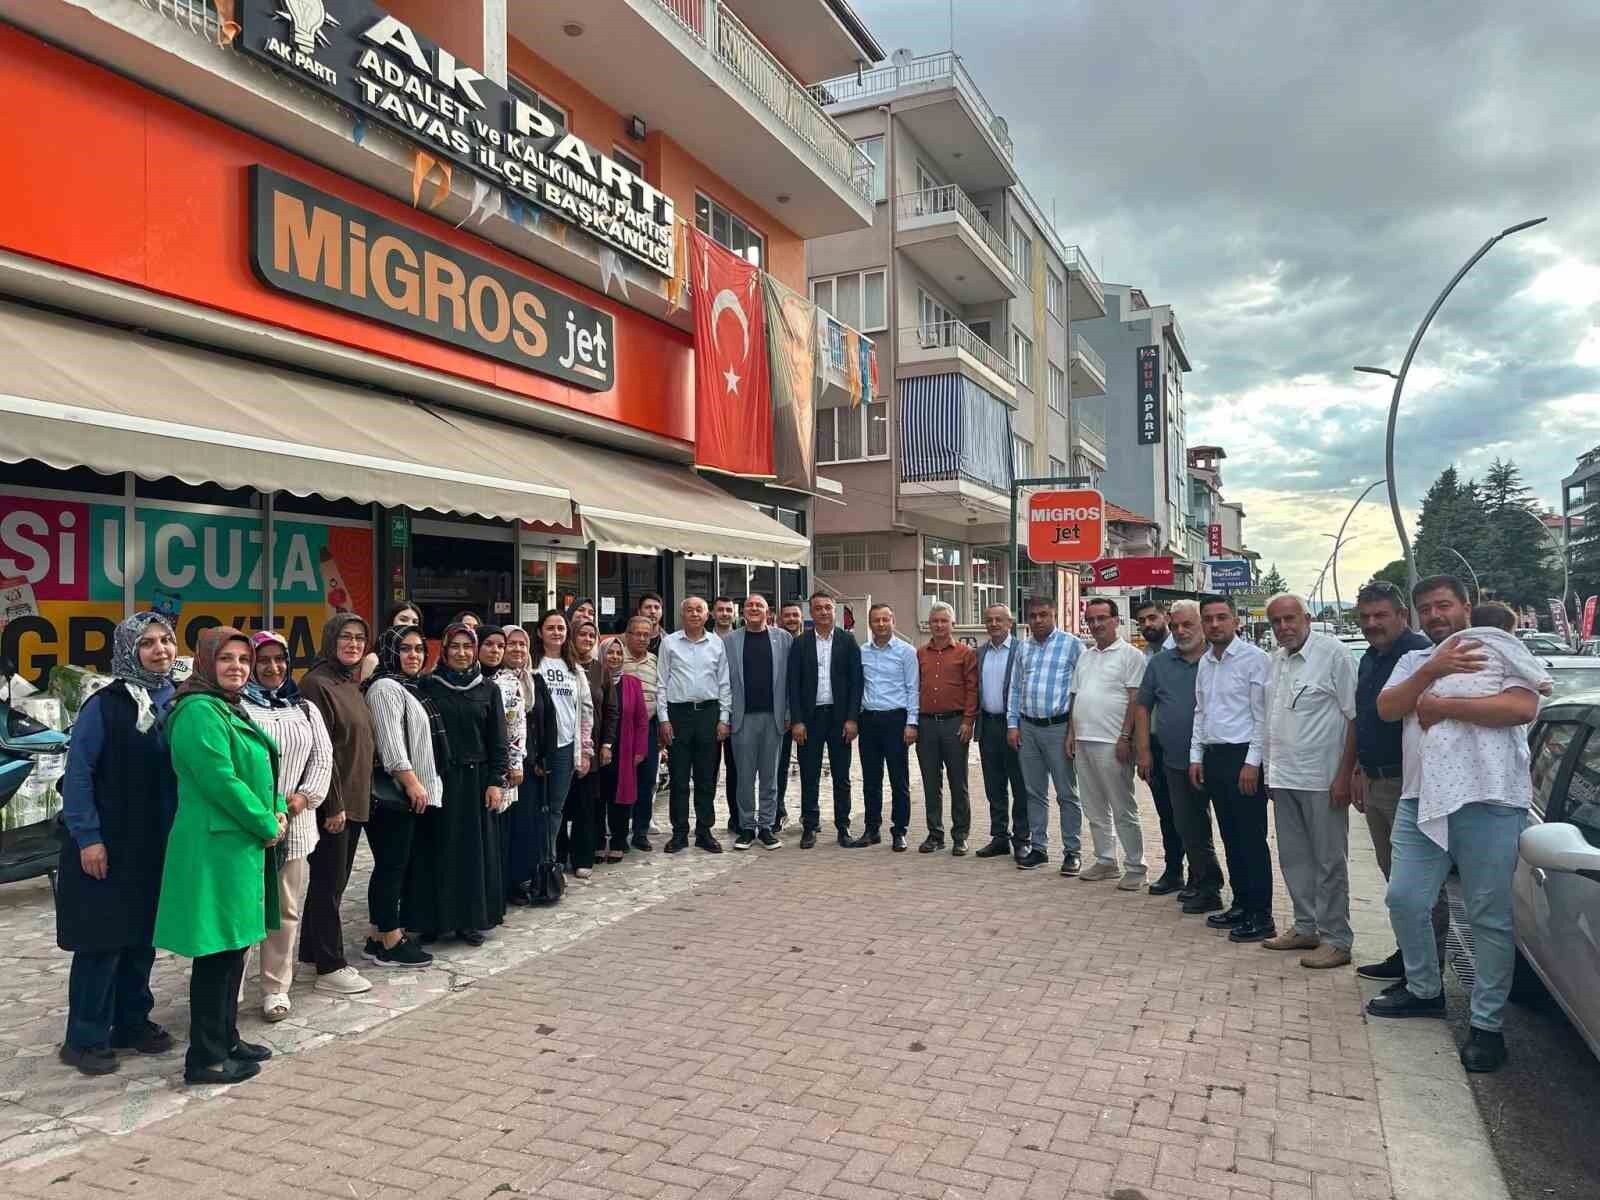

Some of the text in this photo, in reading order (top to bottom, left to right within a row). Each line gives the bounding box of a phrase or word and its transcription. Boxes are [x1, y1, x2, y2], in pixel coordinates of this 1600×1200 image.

[267, 37, 291, 61] AK
[364, 15, 487, 110] AK
[358, 76, 471, 154] TAVAS
[361, 49, 469, 126] ADALET
[476, 119, 501, 145] ve
[508, 133, 610, 211] KALKINMA
[558, 310, 607, 370] jet
[1143, 393, 1155, 440] APART
[103, 518, 318, 591] UCUZA
[1051, 524, 1081, 544] jet
[547, 669, 564, 682] 98
[555, 688, 574, 697] YORK
